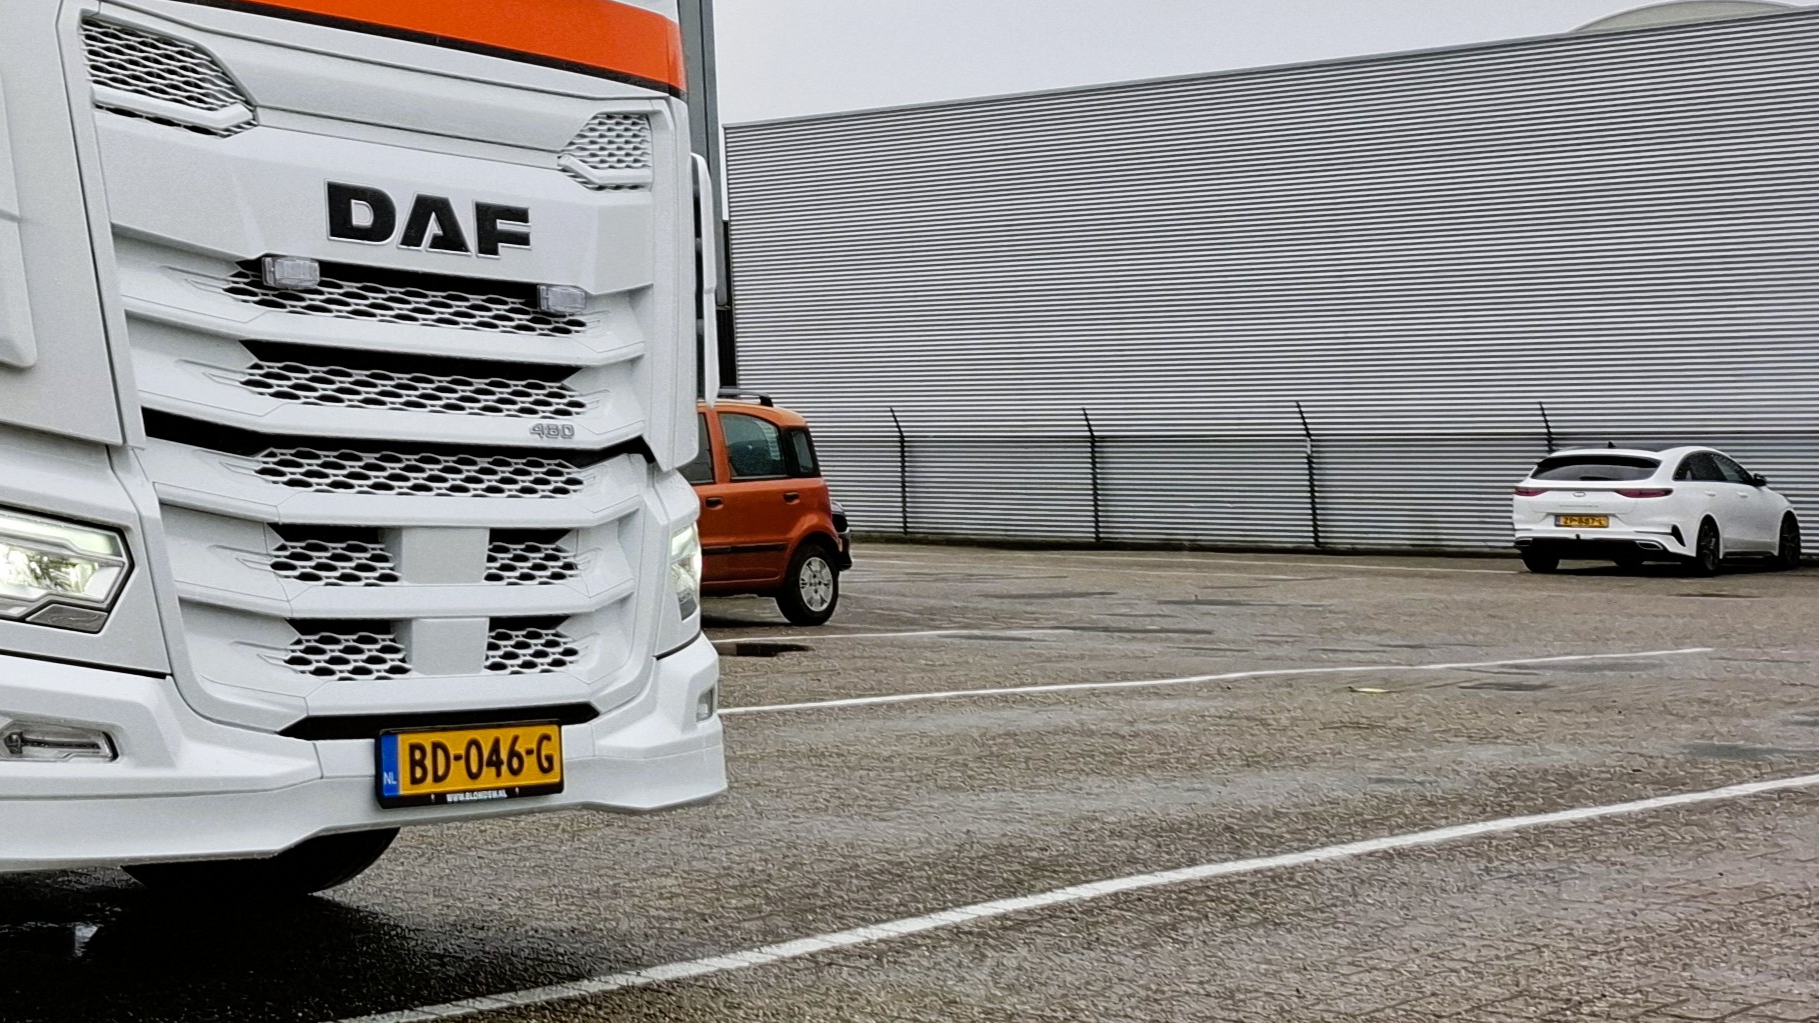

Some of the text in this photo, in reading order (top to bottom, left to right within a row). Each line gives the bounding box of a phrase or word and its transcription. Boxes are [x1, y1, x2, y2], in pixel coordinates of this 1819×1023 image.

[325, 179, 531, 258] DAF
[530, 423, 575, 439] 480
[409, 733, 554, 785] BD-046-G
